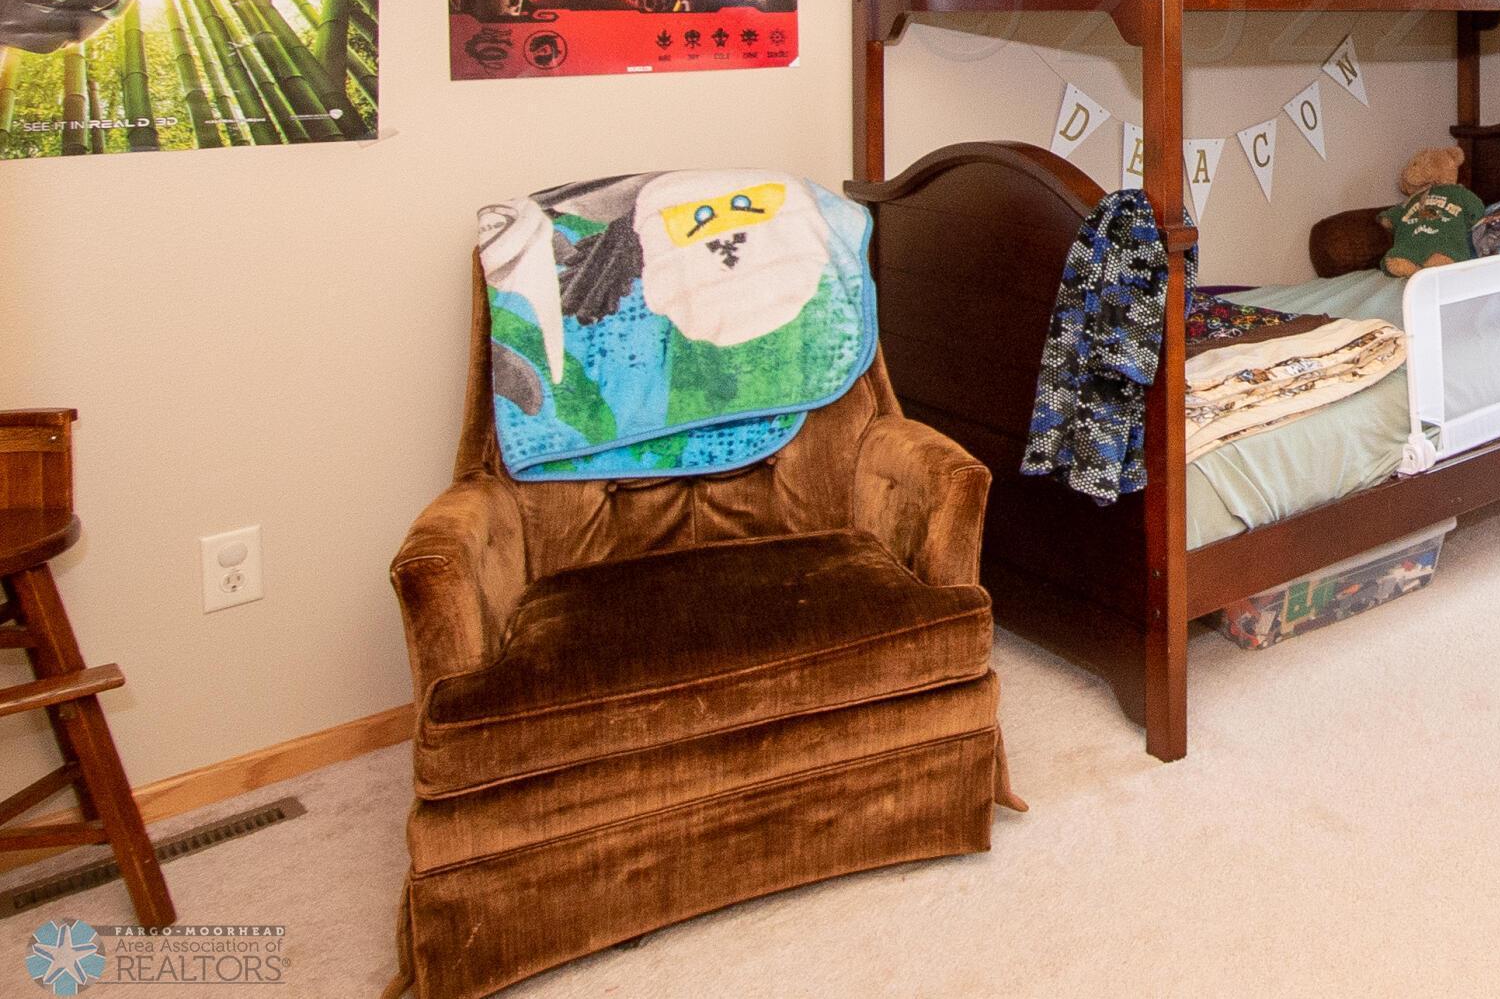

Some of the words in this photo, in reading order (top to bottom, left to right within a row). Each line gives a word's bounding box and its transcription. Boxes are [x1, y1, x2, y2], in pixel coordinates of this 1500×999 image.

[23, 121, 50, 132] SEE
[54, 120, 67, 130] IT
[70, 120, 86, 130] IN
[154, 117, 178, 126] 3D
